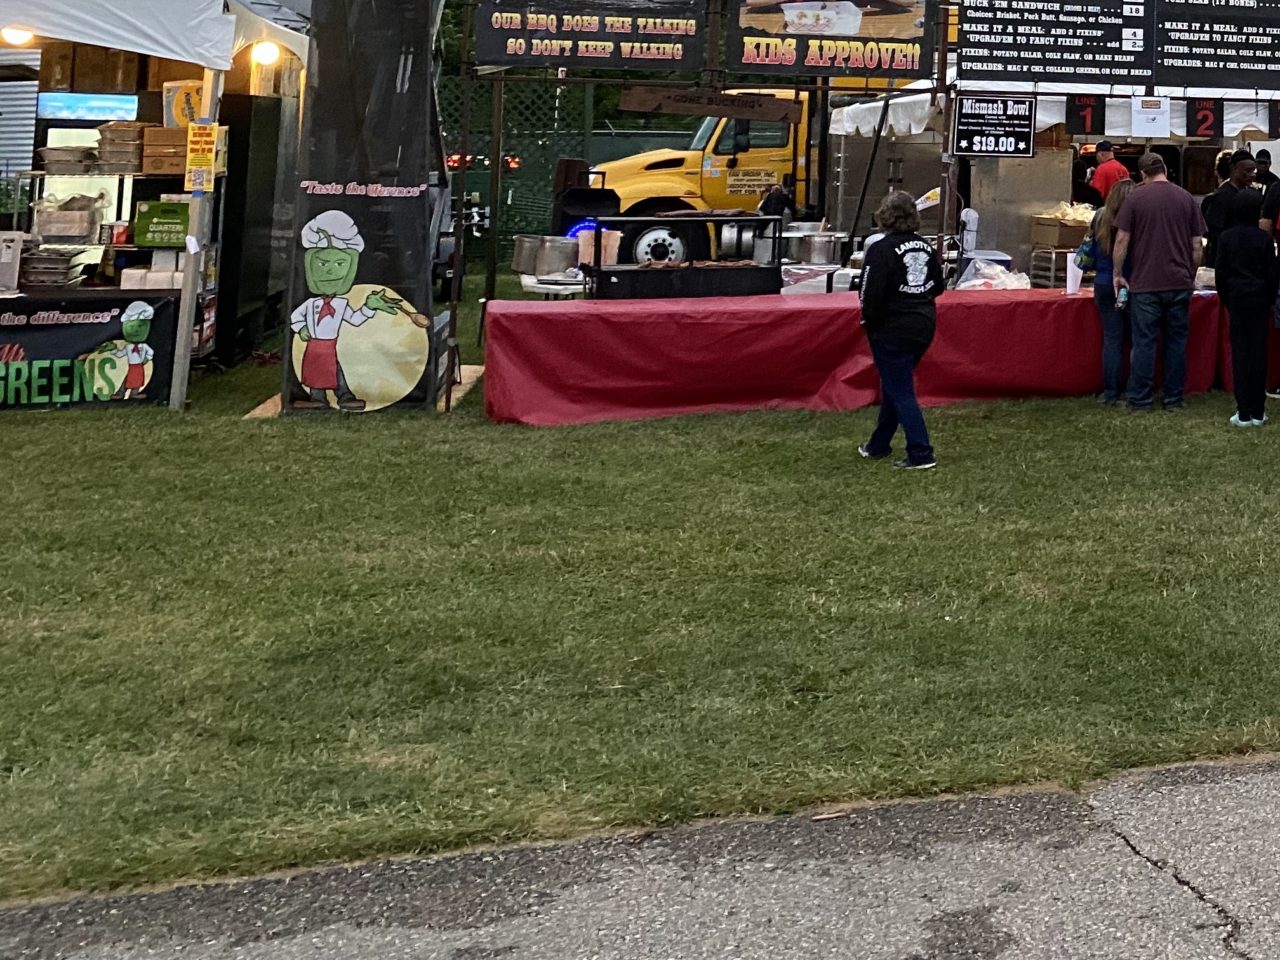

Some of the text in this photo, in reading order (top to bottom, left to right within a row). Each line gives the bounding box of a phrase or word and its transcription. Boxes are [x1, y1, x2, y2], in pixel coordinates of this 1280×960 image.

[491, 12, 696, 36] OUR BBQ DOES THE TALKING
[506, 38, 526, 55] SO
[577, 40, 614, 58] KEEP
[619, 42, 683, 60] WALKING
[741, 36, 921, 71] KIDS APPROVE!!
[962, 99, 1029, 115] Mismash Bowl
[1080, 107, 1093, 133] 1
[1196, 110, 1215, 136] 2
[973, 135, 1015, 152] $19.00
[895, 241, 932, 255] LAMOTTA
